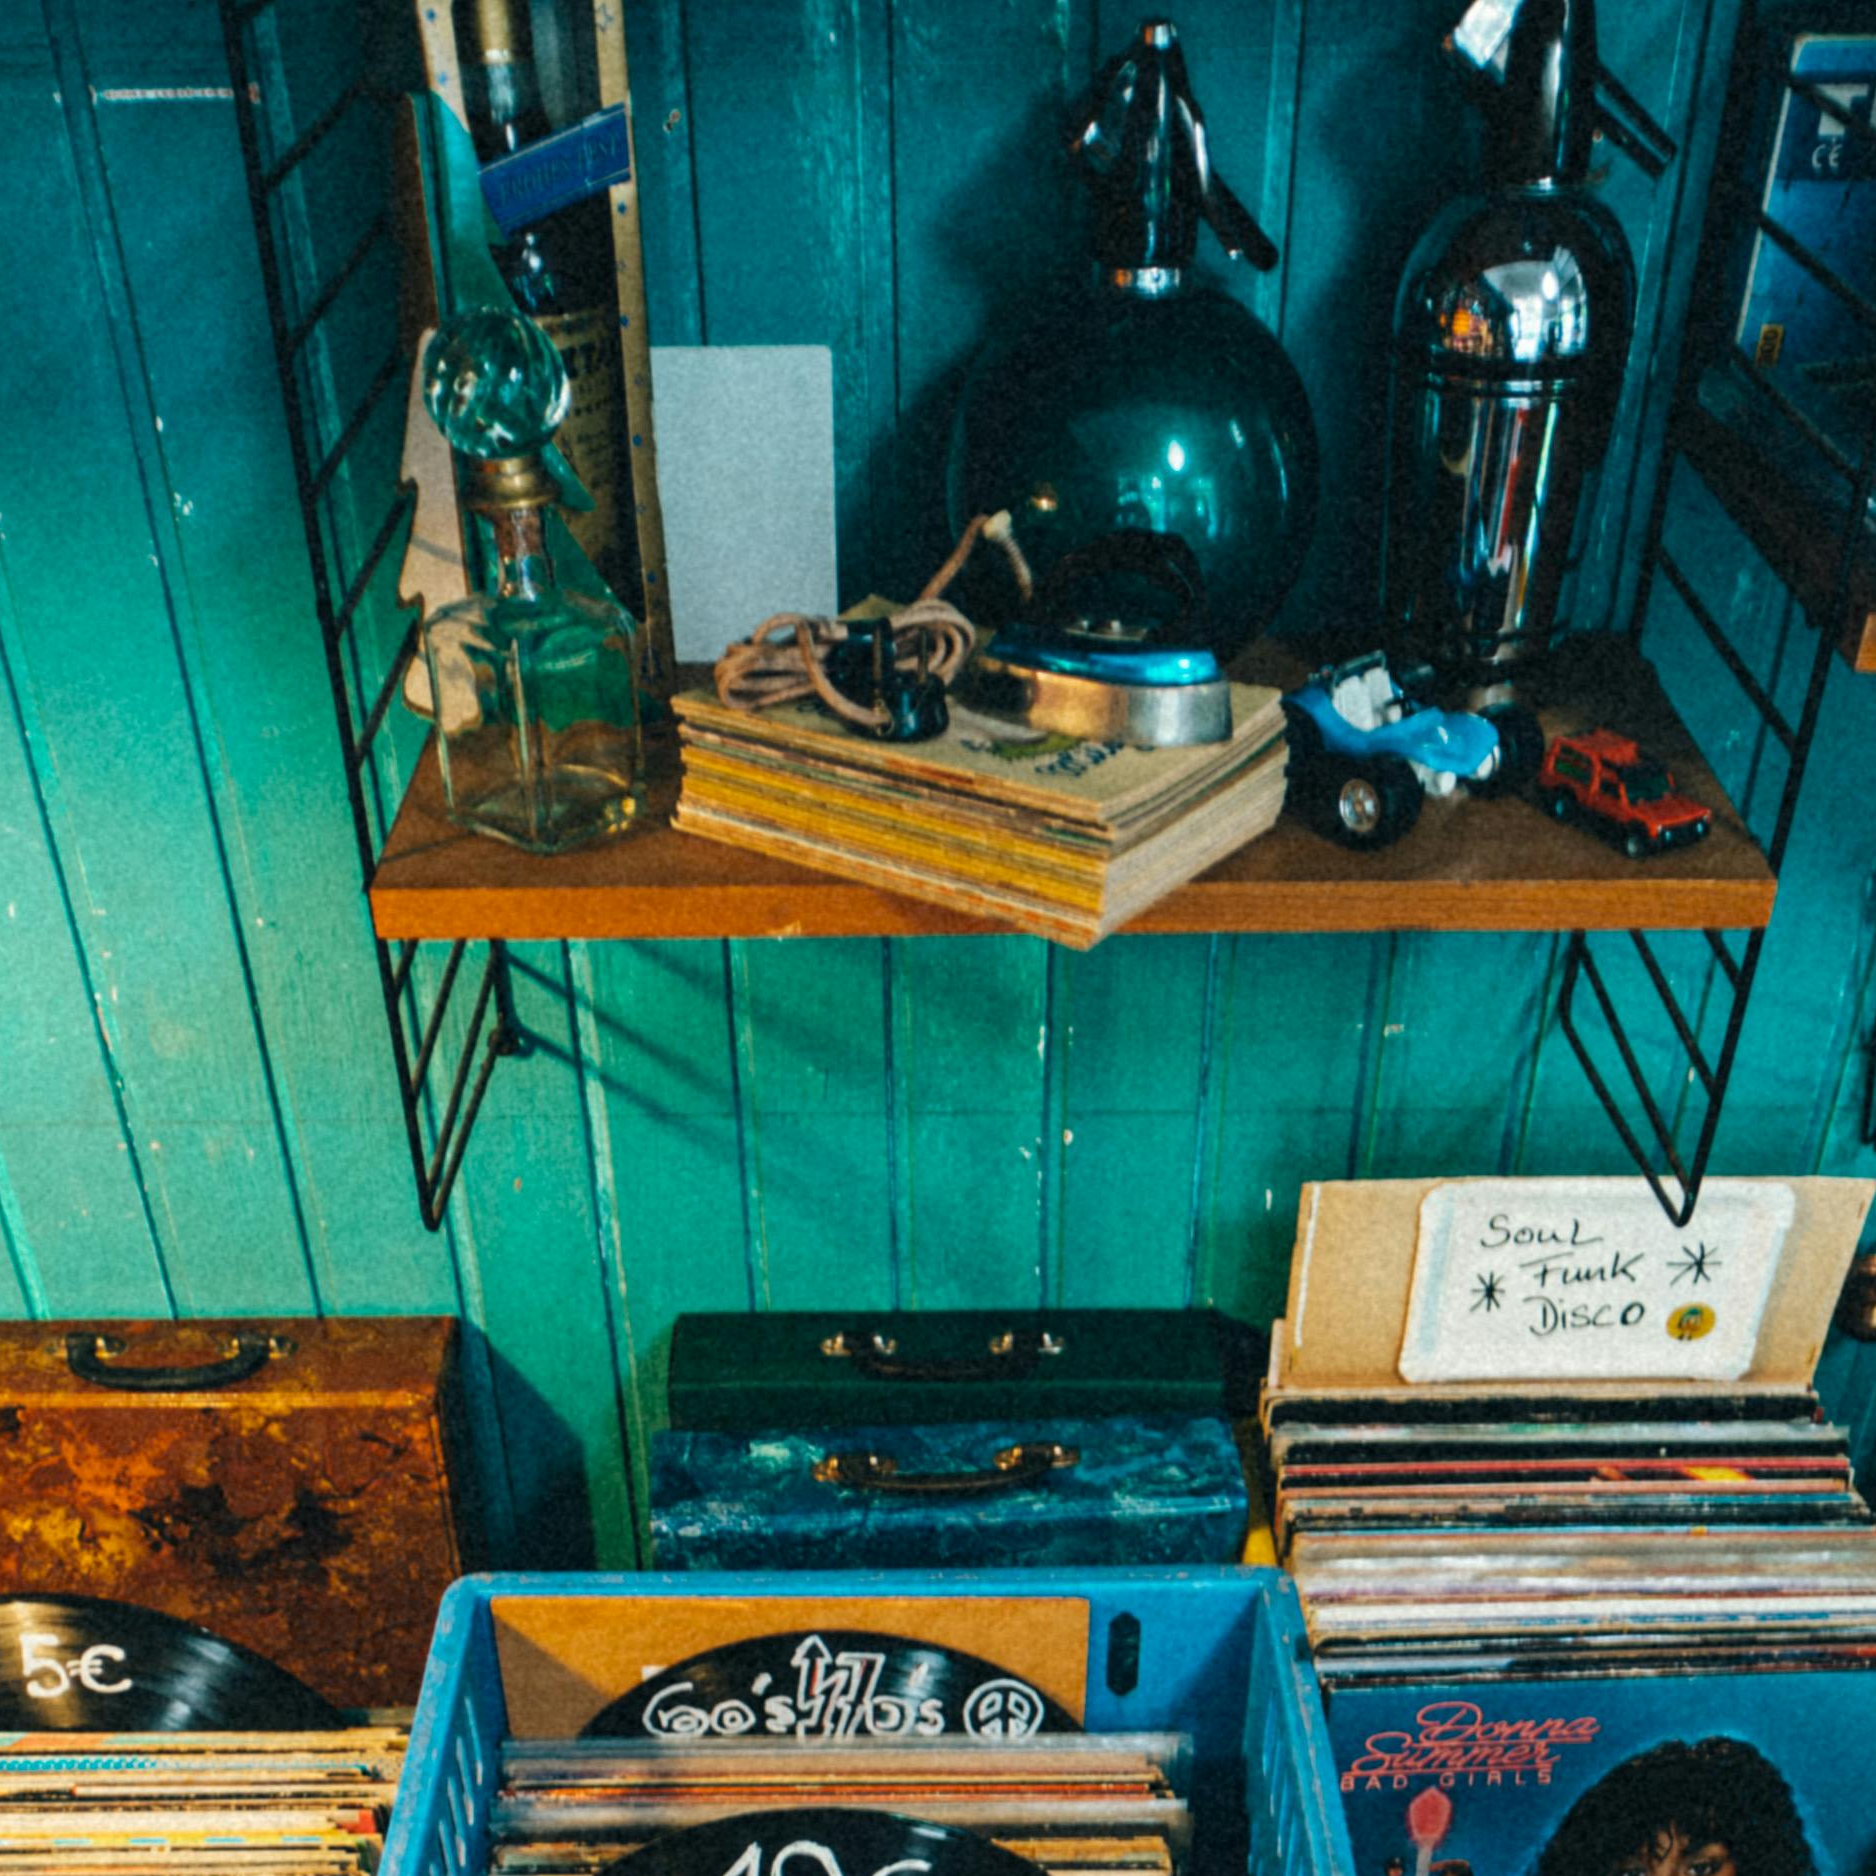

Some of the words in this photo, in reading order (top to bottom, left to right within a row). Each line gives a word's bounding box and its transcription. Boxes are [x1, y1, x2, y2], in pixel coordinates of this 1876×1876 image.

[18, 1632, 134, 1699] 5€
[1416, 1700, 1601, 1746] Donna
[1350, 1731, 1561, 1775] Summer
[1340, 1773, 1409, 1792] BAD
[1439, 1771, 1553, 1789] GIRLS
